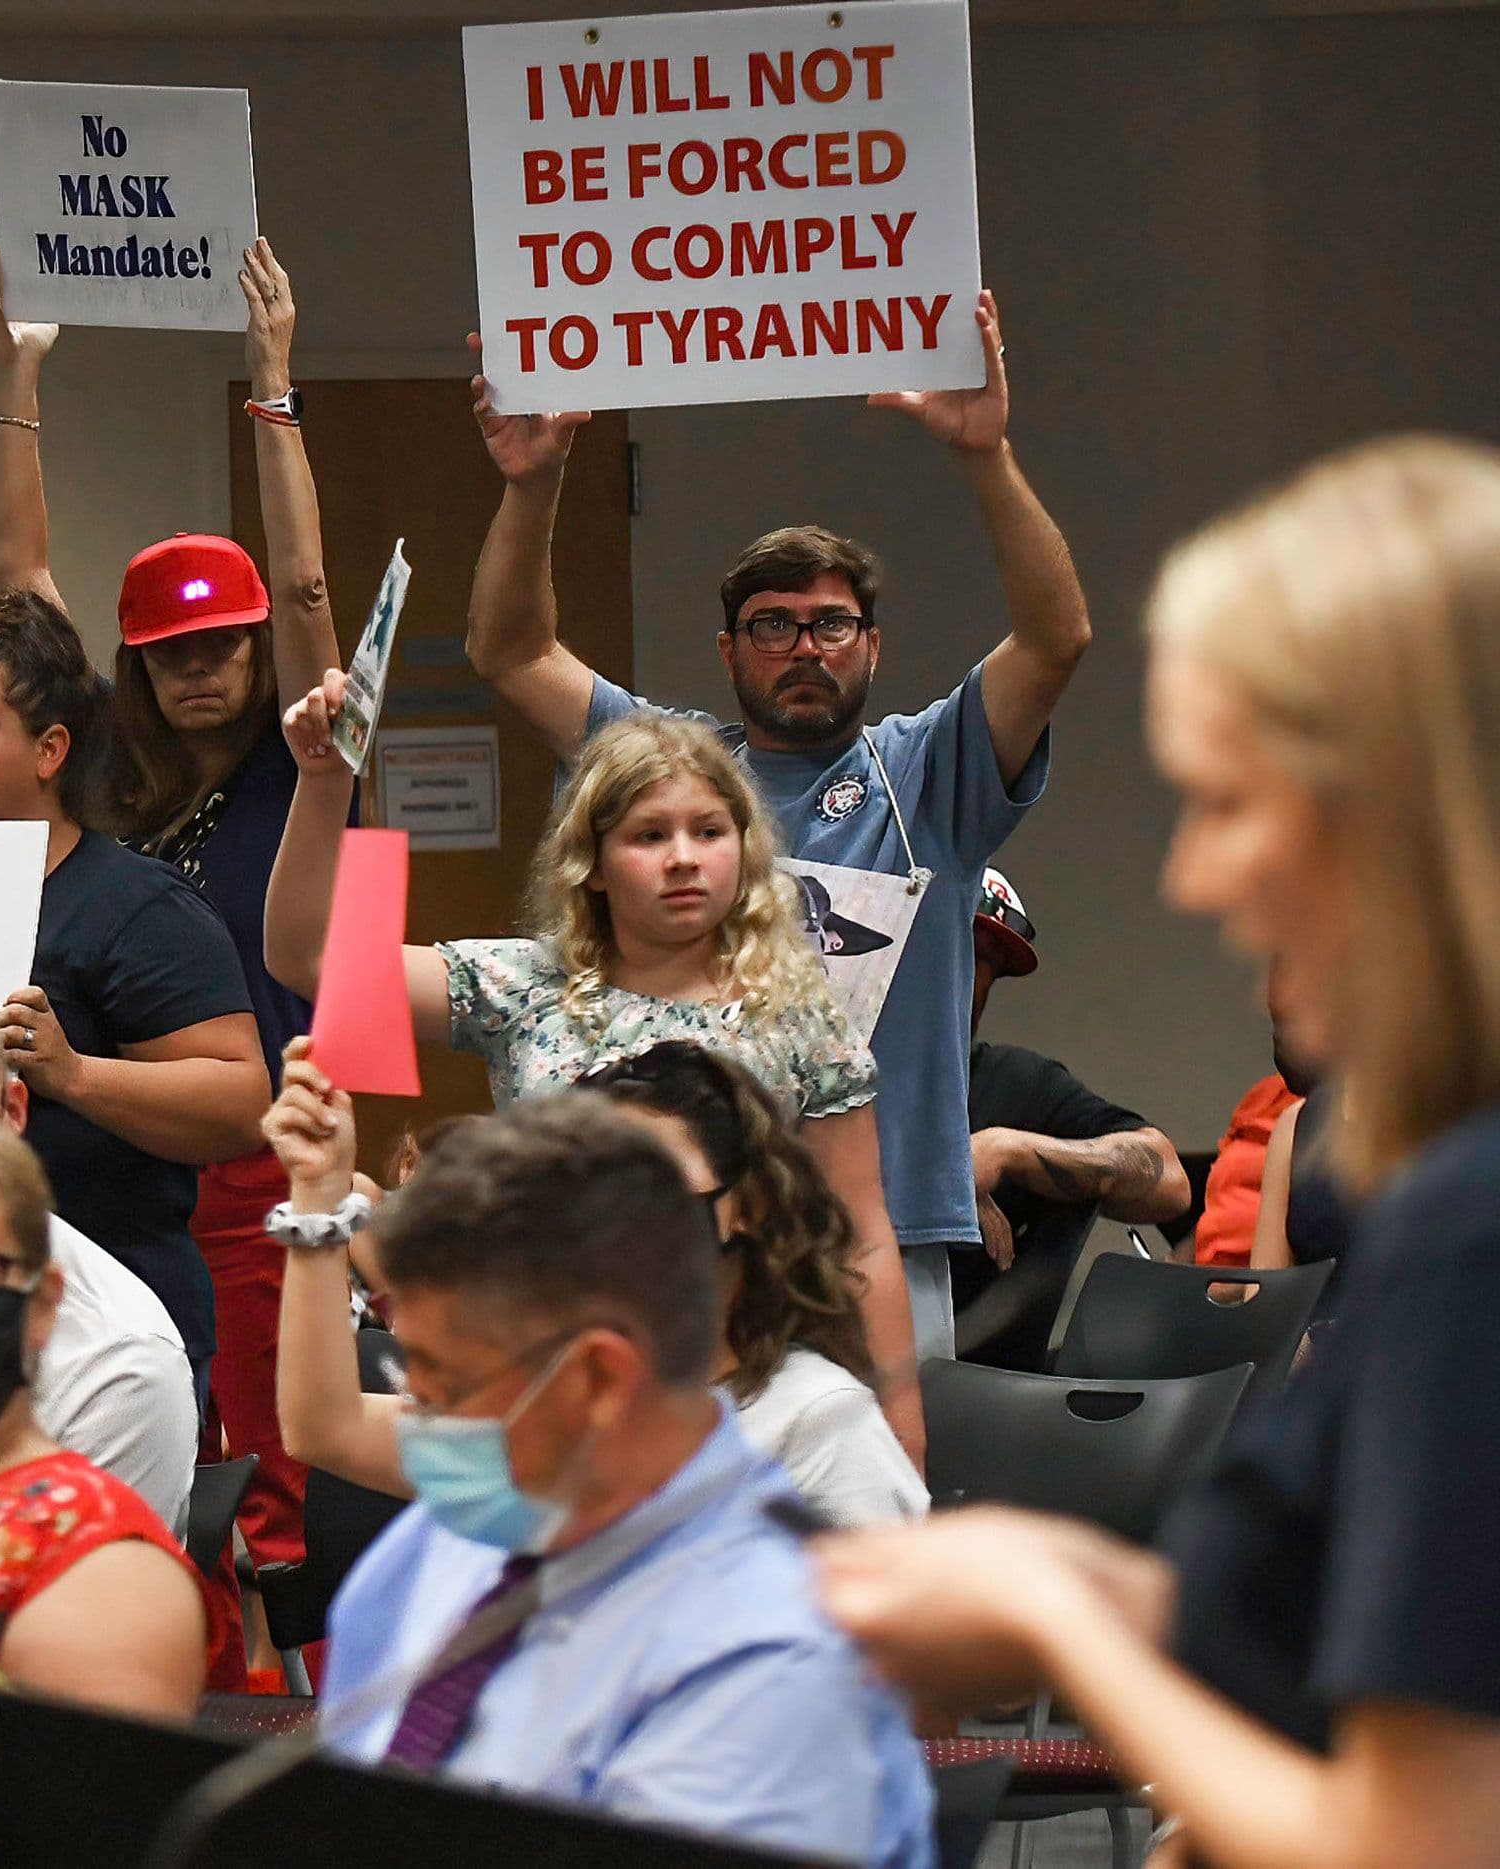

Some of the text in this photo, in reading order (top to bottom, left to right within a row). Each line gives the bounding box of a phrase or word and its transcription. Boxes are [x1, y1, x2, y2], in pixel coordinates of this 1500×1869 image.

[526, 44, 895, 120] I WILL NOT
[81, 115, 127, 158] No
[523, 130, 907, 204] BE FORCED
[58, 174, 176, 218] MASK
[35, 233, 212, 279] Mandate!
[519, 211, 917, 288] TO COMPLY
[506, 293, 952, 372] TO TYRANNY
